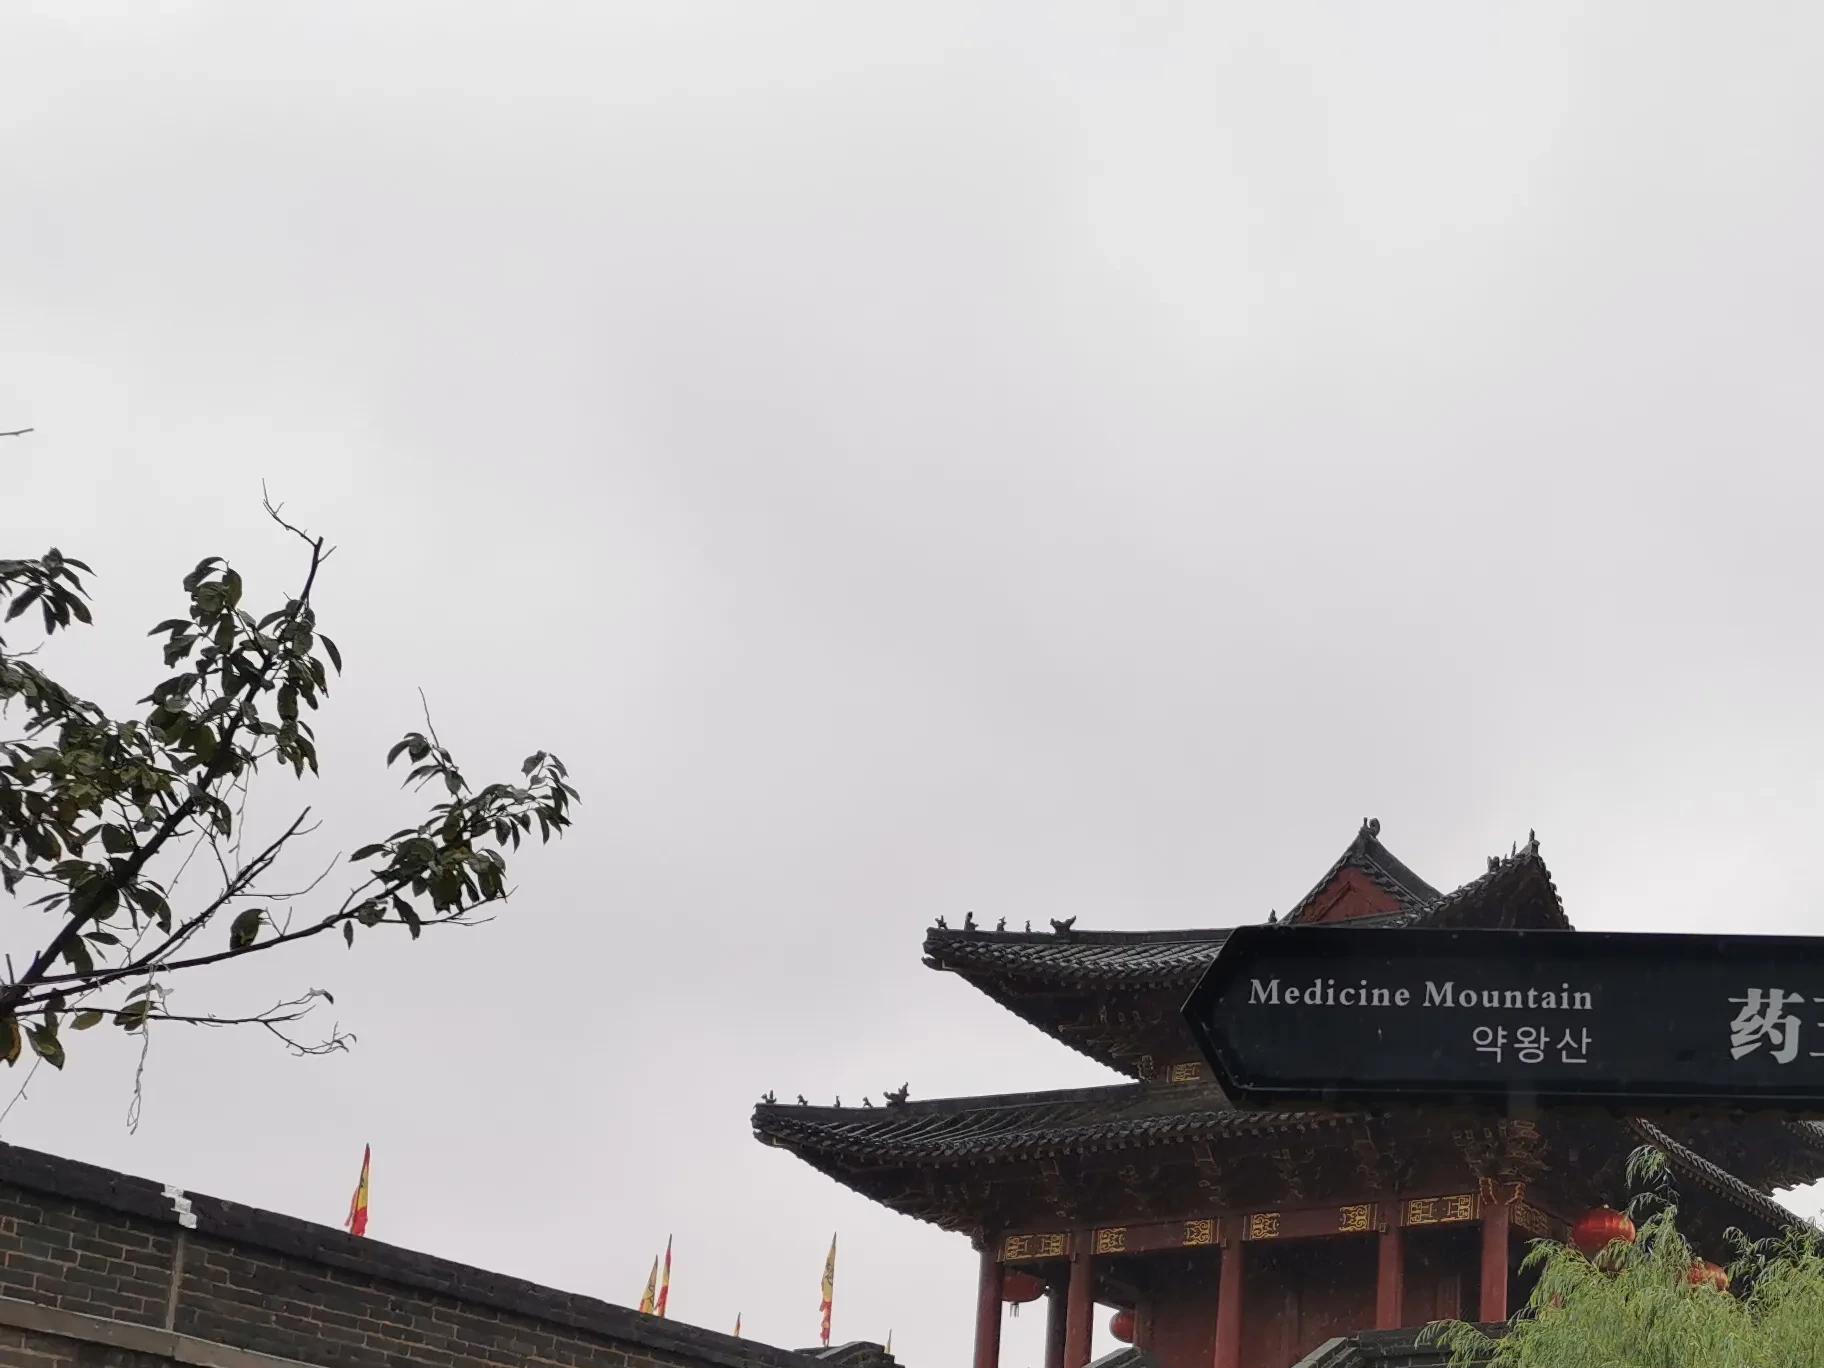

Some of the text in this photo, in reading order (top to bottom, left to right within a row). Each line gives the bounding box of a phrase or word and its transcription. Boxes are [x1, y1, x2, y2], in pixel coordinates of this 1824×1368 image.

[1249, 979, 1593, 1010] Medicine Mountain
[1472, 1025, 1592, 1064] 약왕산
